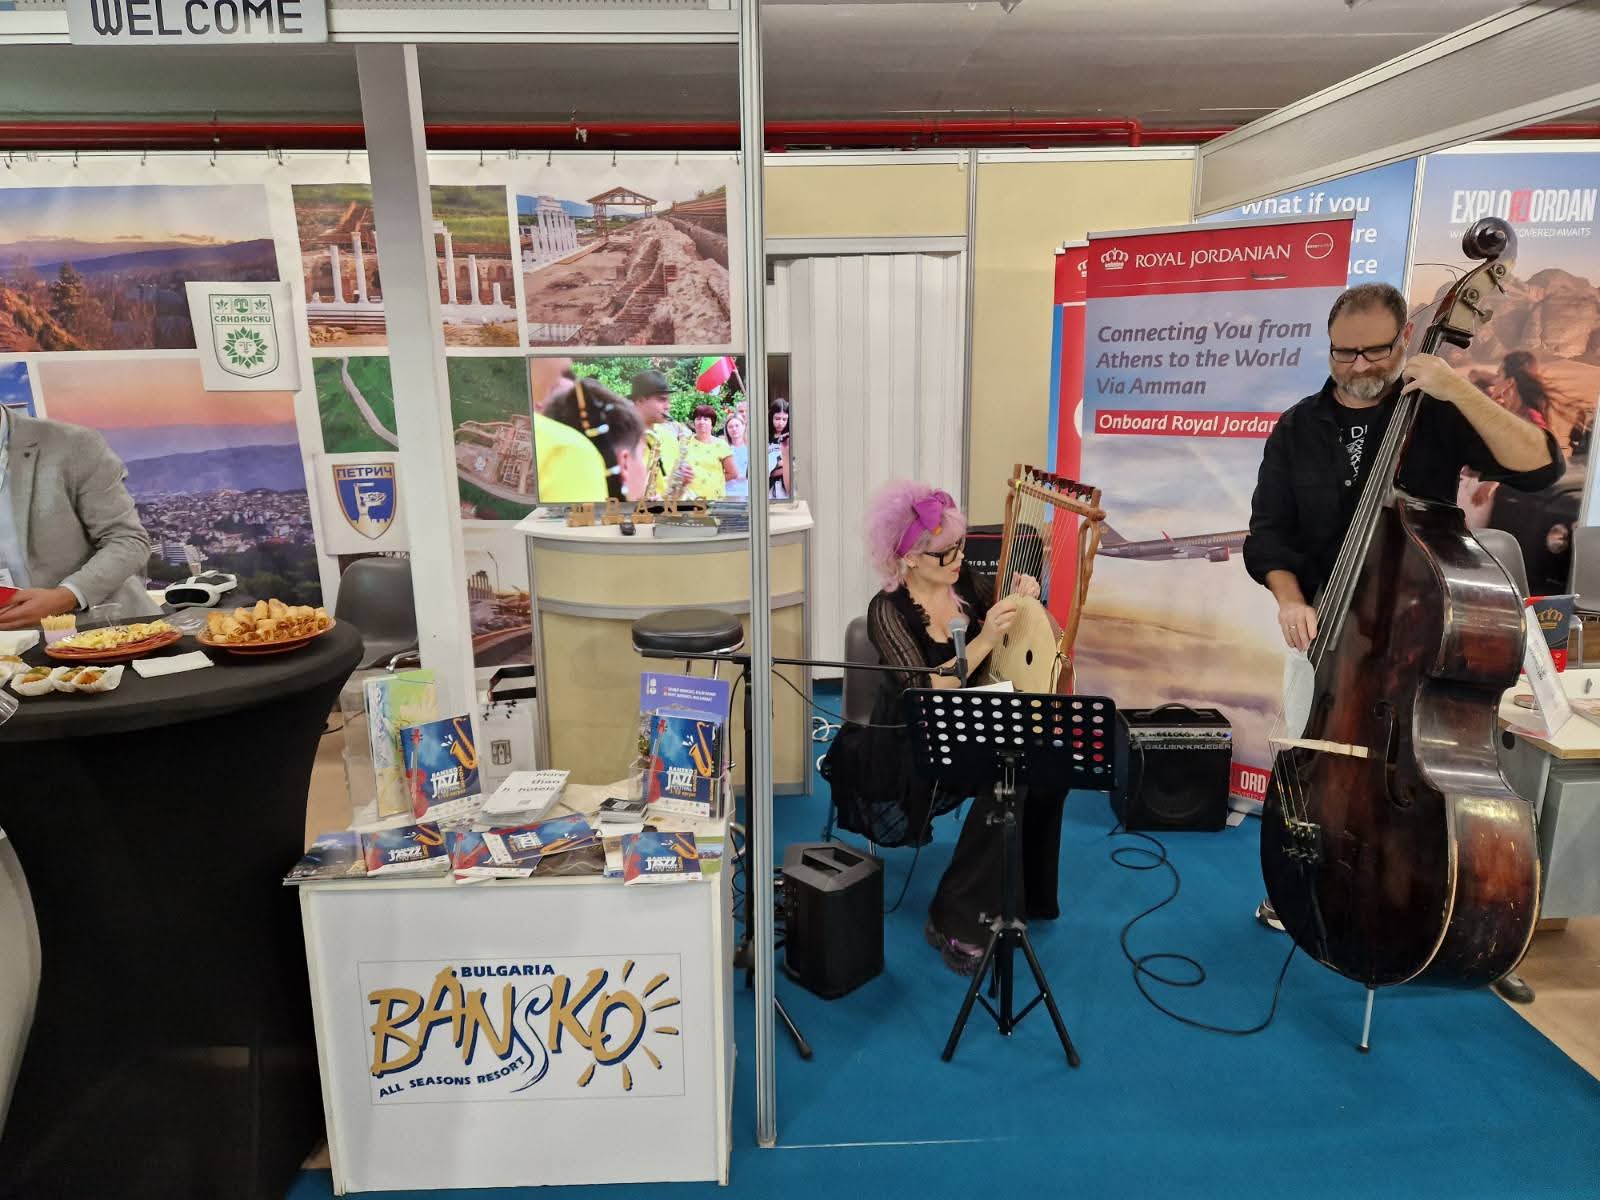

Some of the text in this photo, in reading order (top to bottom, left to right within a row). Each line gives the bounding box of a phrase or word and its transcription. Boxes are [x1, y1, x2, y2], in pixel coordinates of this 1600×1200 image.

[90, 0, 303, 36] WELCOME
[1308, 191, 1325, 215] if
[1557, 227, 1592, 237] AWAITS
[1135, 244, 1292, 269] ROYAL JORDANIAN
[1098, 319, 1312, 345] Connecting You from
[1096, 347, 1301, 369] Athens to the World
[1096, 377, 1206, 395] Via Amman
[1100, 414, 1168, 430] Onboard
[1172, 415, 1218, 435] Royal
[336, 466, 392, 478] ПЕТРИЧ
[430, 774, 460, 798] JAZZ
[665, 771, 693, 791] JAZZ
[645, 858, 678, 871] JAZZ
[461, 964, 555, 978] BULGARIA
[367, 965, 647, 1092] BANSKO
[379, 1056, 525, 1098] ALL SEASONS RESORT
